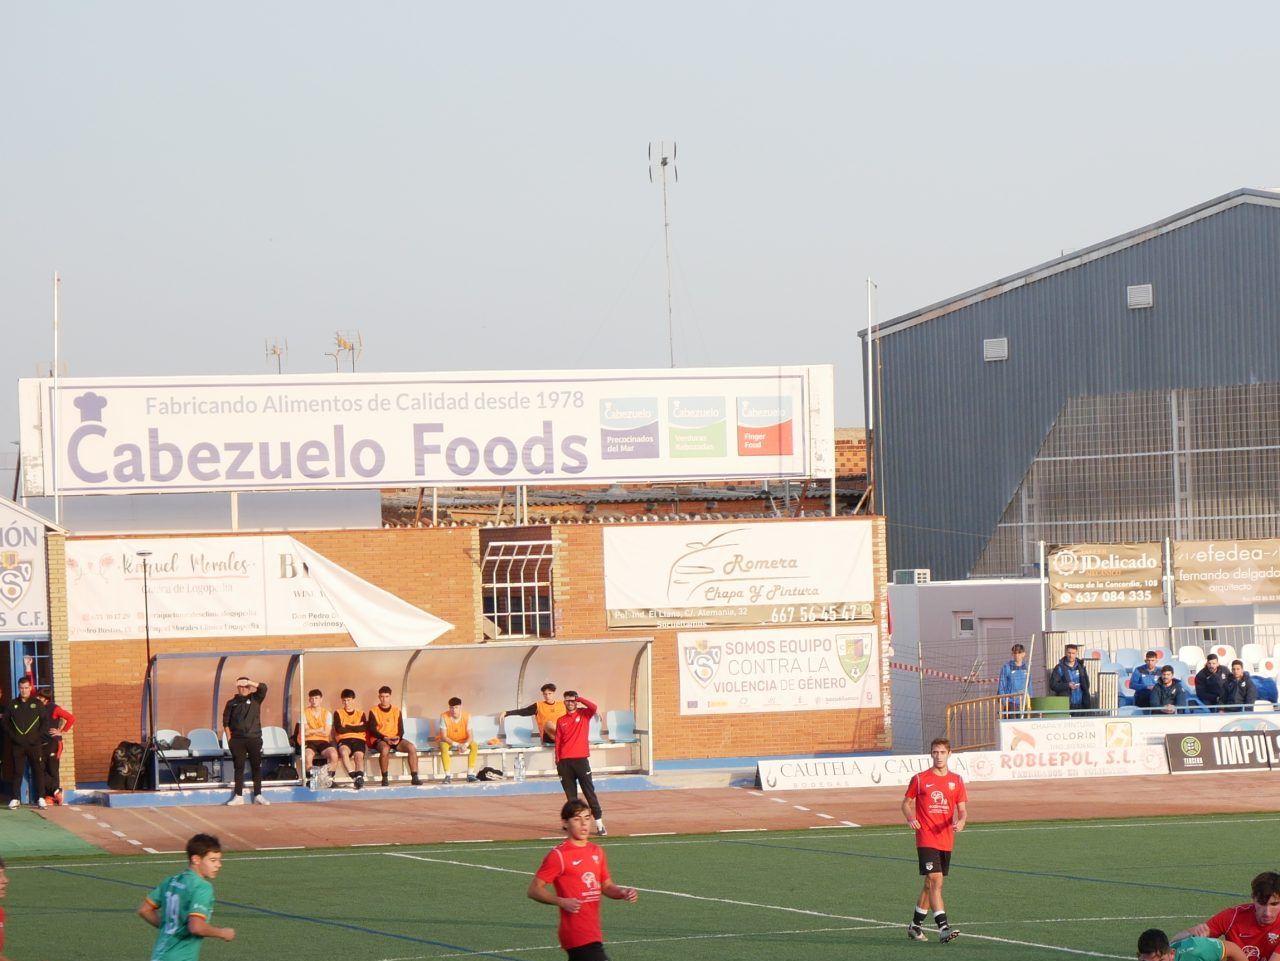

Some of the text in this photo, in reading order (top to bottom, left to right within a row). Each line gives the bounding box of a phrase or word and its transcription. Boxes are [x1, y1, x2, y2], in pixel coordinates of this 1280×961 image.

[146, 389, 585, 417] Fabricando Alimentos de Calidad desde 1978
[672, 404, 721, 419] Cabezuelo
[742, 403, 786, 419] Cabezuelo
[604, 405, 652, 420] Cabezuelo
[607, 434, 654, 445] Precocinados
[744, 432, 767, 442] Finger
[744, 440, 763, 450] Food
[67, 420, 589, 485] Cabezuelo Foods
[607, 443, 635, 453] del Mar
[1195, 543, 1263, 562] efedea
[722, 553, 799, 576] Romera
[1078, 552, 1157, 574] JDelicado
[1179, 567, 1231, 581] fernando
[704, 585, 745, 604] Chapa
[766, 584, 821, 601] Pintura
[1075, 590, 1152, 604] 637 084 335
[17, 610, 44, 627] C.F.
[738, 608, 749, 617] 32
[770, 605, 857, 622] 667 56 45 47
[724, 637, 832, 656] SOMOS EQUIPO
[728, 656, 832, 676] CONTRA LA
[713, 675, 847, 694] VIOLENCIA DE GÉNERO
[1000, 750, 1137, 770] ROBLEPOL, S.L.
[779, 759, 864, 779] CAUTELA
